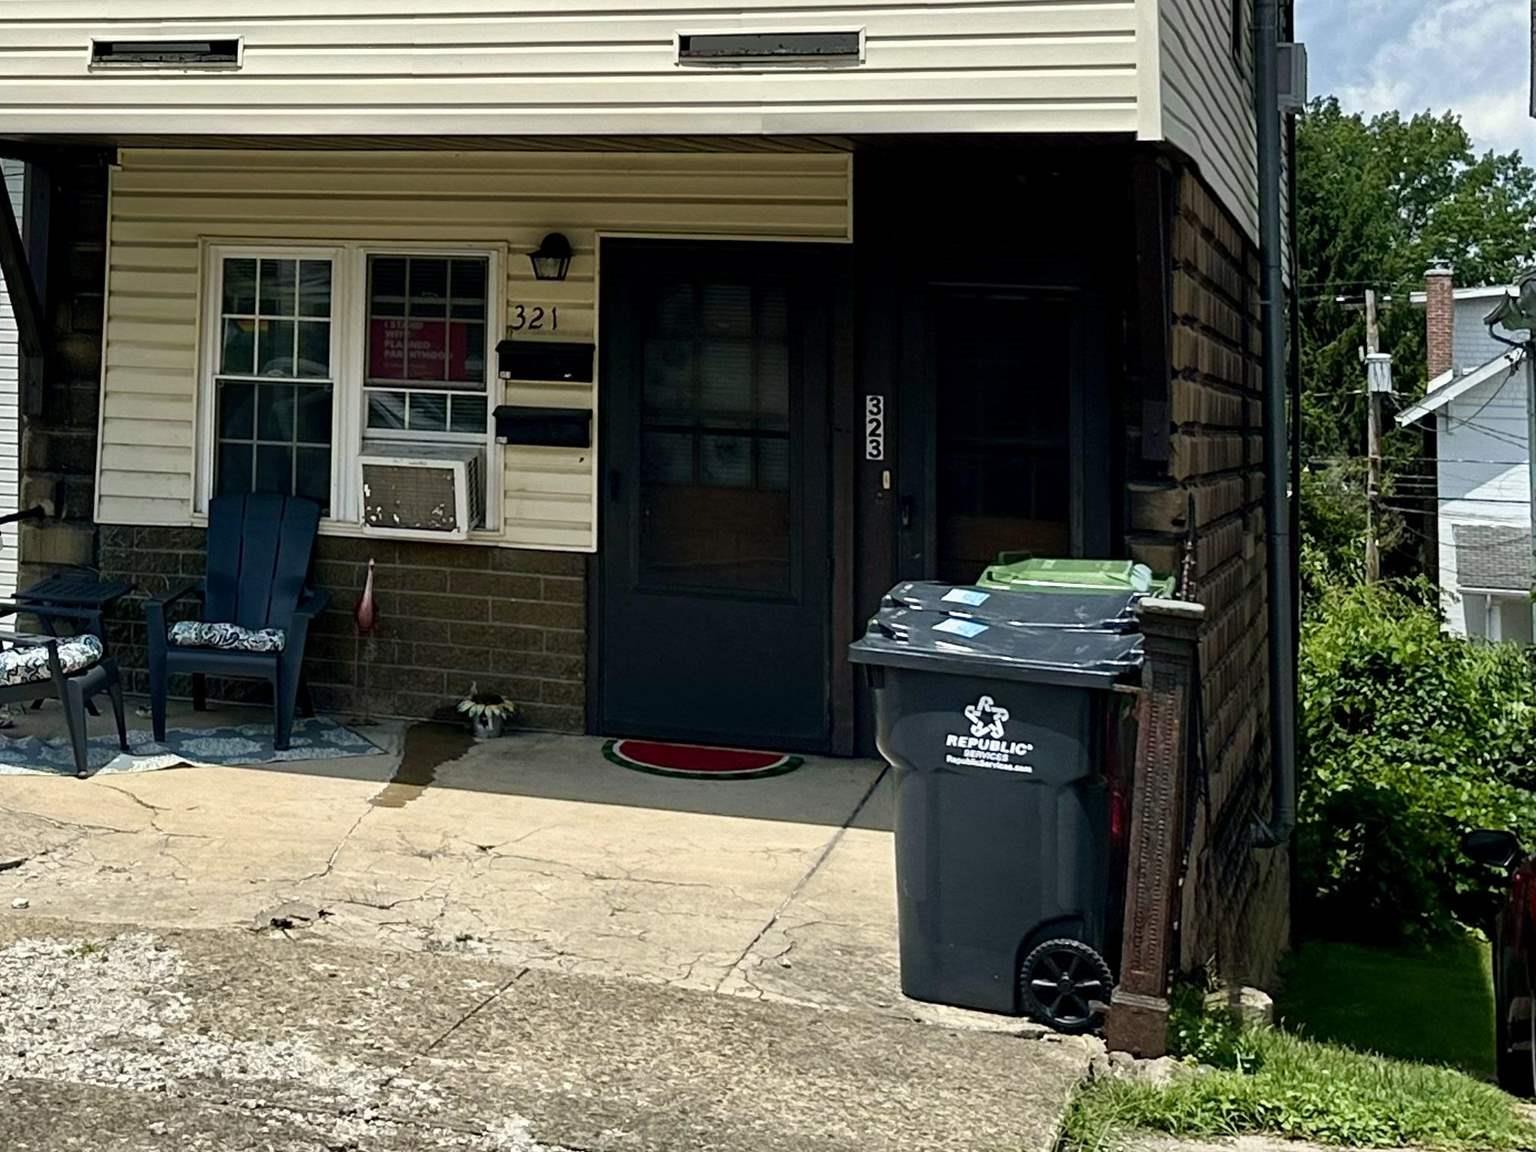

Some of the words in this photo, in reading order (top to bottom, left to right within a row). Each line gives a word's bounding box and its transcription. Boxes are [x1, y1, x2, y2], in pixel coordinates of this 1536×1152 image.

[511, 304, 557, 330] 321
[868, 396, 882, 458] 323
[946, 734, 1028, 756] REPUBLIC
[963, 749, 1009, 762] SERVICES
